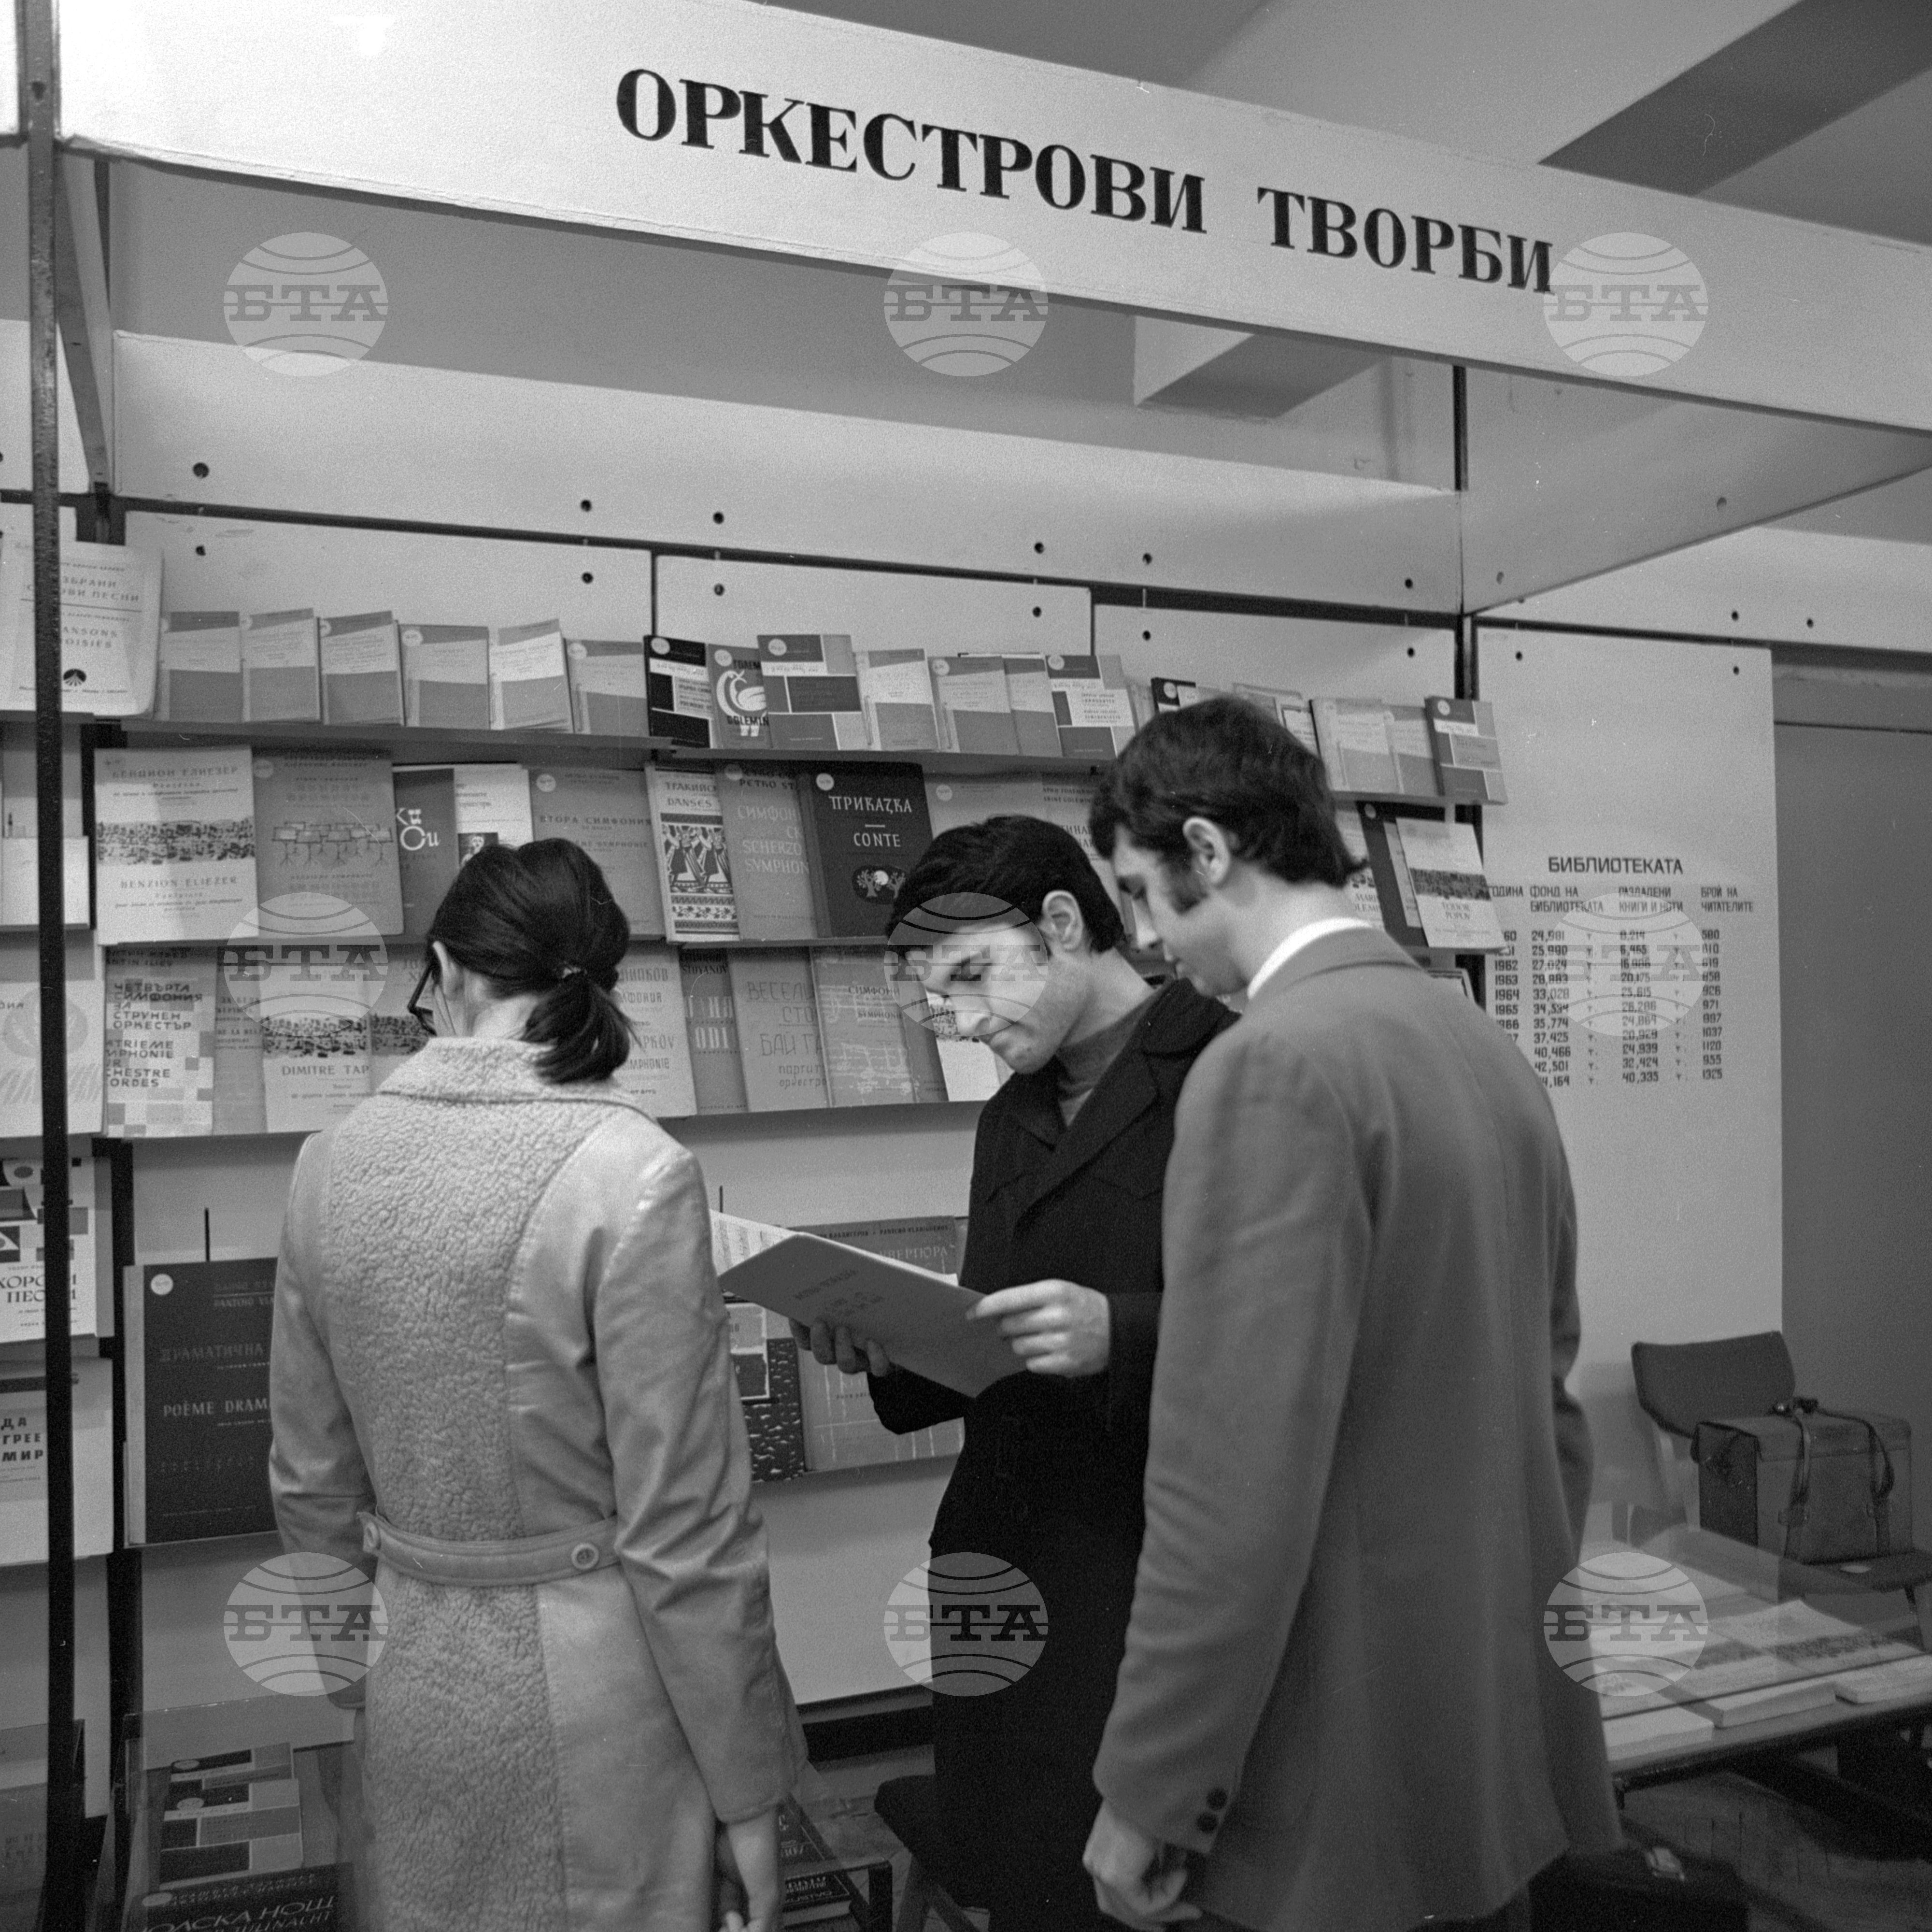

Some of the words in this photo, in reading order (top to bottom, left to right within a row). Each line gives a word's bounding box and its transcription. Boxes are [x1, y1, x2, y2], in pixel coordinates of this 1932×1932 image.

[614, 68, 1208, 234] ОРКЕСТРОВИ
[1257, 186, 1553, 294] ТВОРБИ
[828, 795, 912, 815] ПРИКАЗКА
[853, 832, 902, 848] CONTE
[742, 839, 802, 856] SCHERZO
[1548, 856, 1684, 875] БИБЛИОТЕКАТА
[1529, 884, 1561, 898] ФОНД
[1565, 886, 1579, 898] НА
[1618, 886, 1672, 898] РАЗДАДЕНИ
[1701, 885, 1722, 898] БРОЙ
[1727, 886, 1738, 898] НА
[1530, 900, 1604, 913] БИБЛИОТЕКАТА
[1619, 901, 1648, 913] КНИГИ
[1701, 901, 1754, 913] ЧИТАТЕЛИТЕ
[1494, 959, 1519, 971] 1962
[1495, 974, 1519, 986] 1963
[114, 982, 190, 993] ЧЕТВЪРТА
[114, 992, 203, 1002] СИМФОНИЯ
[1495, 988, 1520, 1001] 1964
[1495, 1003, 1519, 1015] 1965
[113, 1011, 181, 1021] СТРУНЕН
[113, 1020, 192, 1031] ОРКЕСТЪР
[282, 1065, 335, 1076] DIMITRE
[344, 1064, 370, 1075] TAP
[225, 1398, 269, 1415] DRAM
[1, 1417, 27, 1431] ДА
[2, 1432, 41, 1445] ГРЕЕ
[2, 1449, 44, 1462] МИР
